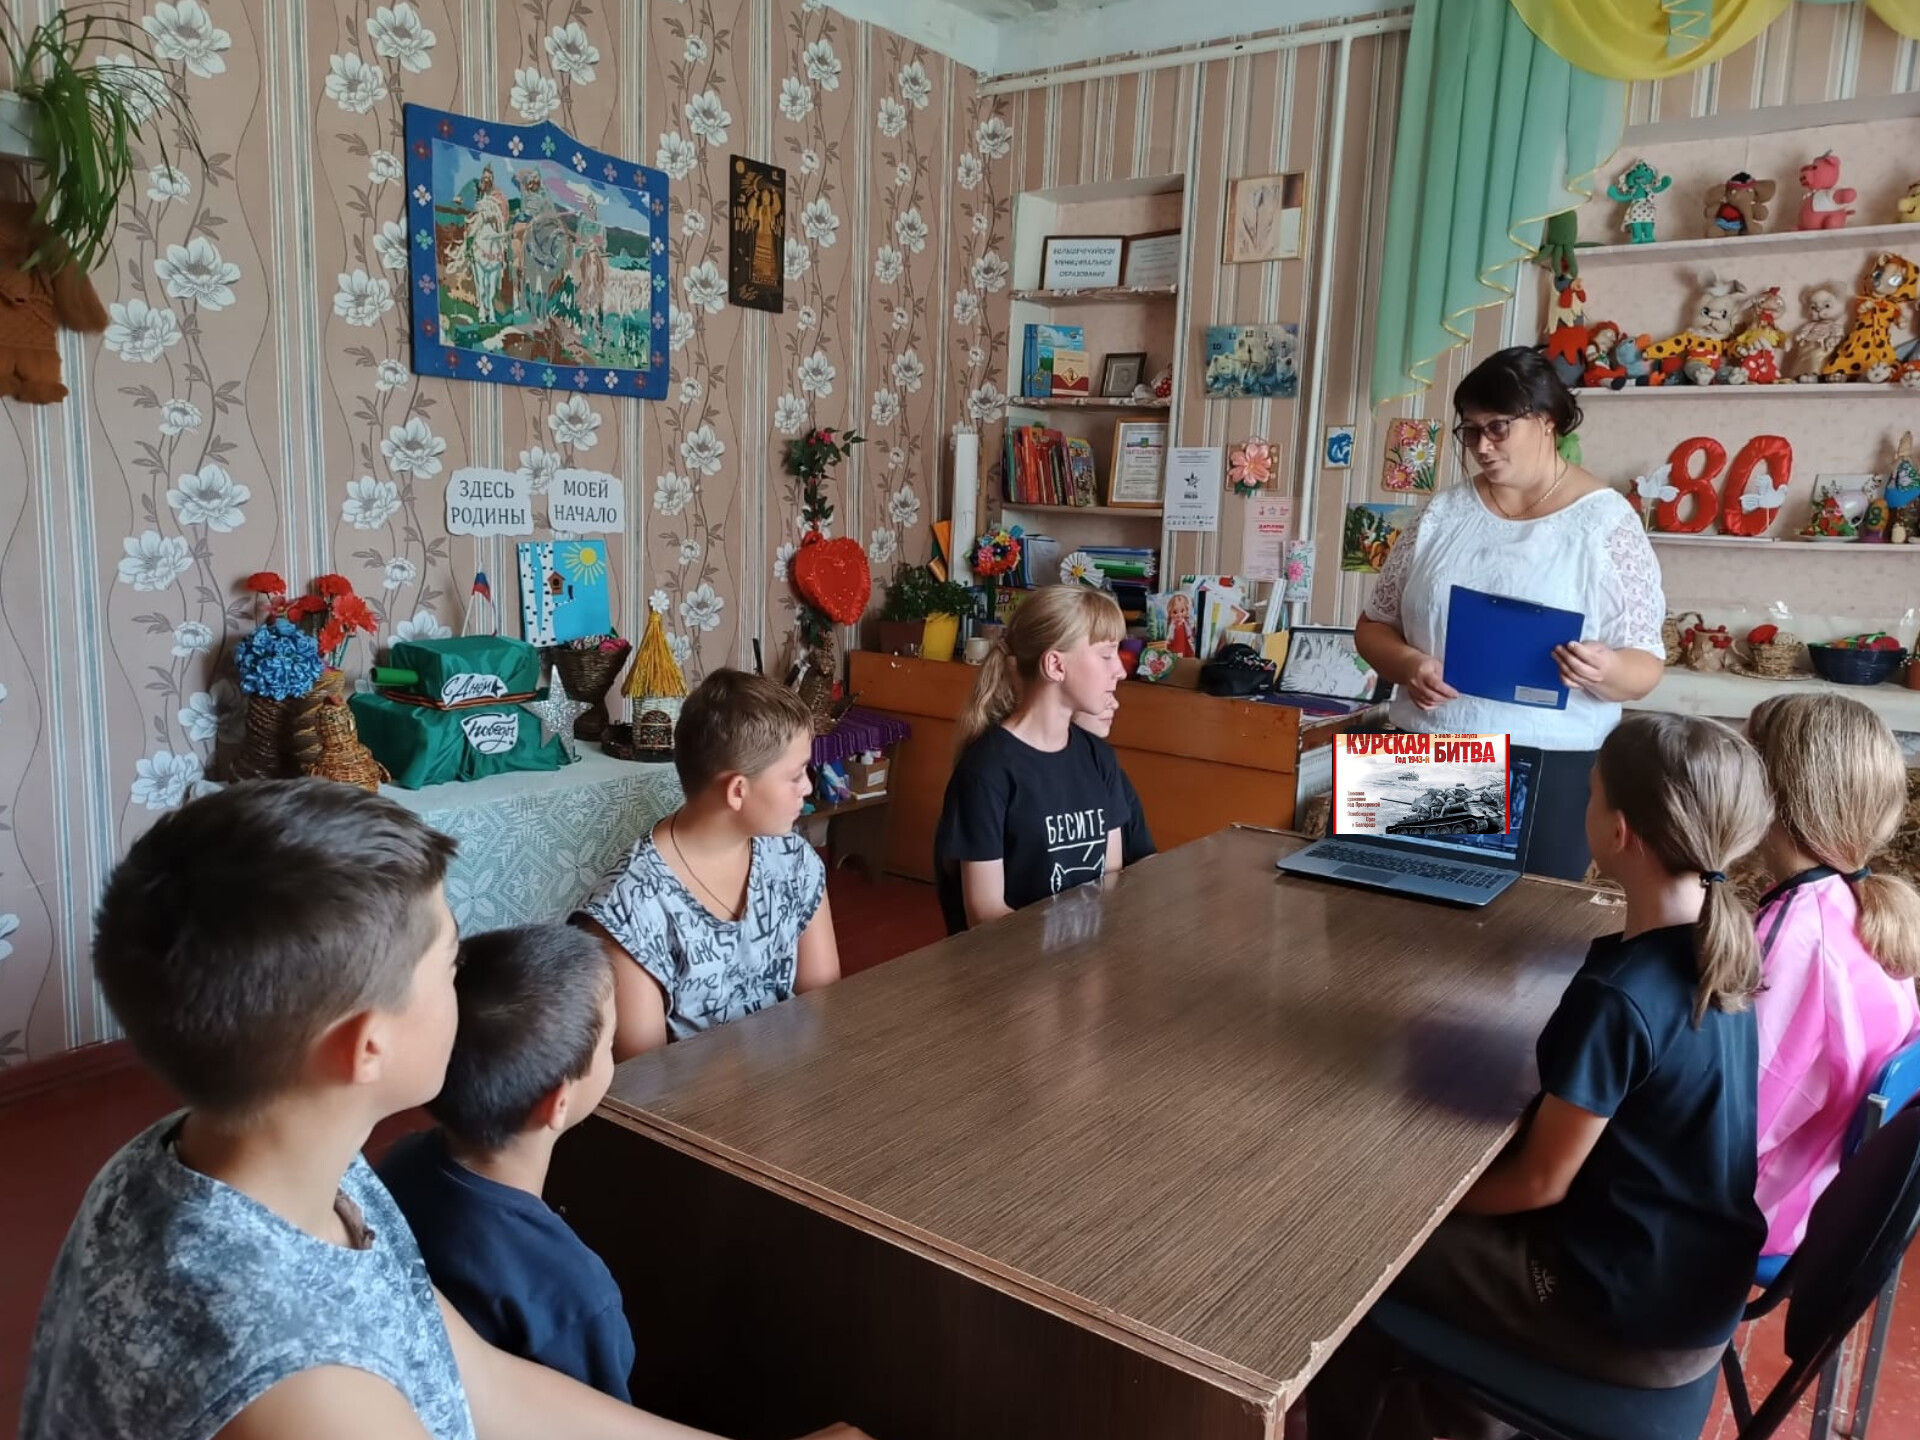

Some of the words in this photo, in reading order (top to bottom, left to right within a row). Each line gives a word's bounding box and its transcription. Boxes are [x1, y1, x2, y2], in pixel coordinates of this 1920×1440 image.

[459, 480, 515, 500] ЗДЕСЬ
[563, 479, 609, 498] МОЕЙ
[451, 506, 526, 527] РОДИНЫ
[554, 504, 617, 523] НАЧАЛО
[1346, 734, 1431, 755] КУРСКАЯ
[1434, 741, 1496, 763] БИТВА
[1395, 756, 1407, 764] Год
[1045, 808, 1106, 845] БЕСИТЕ
